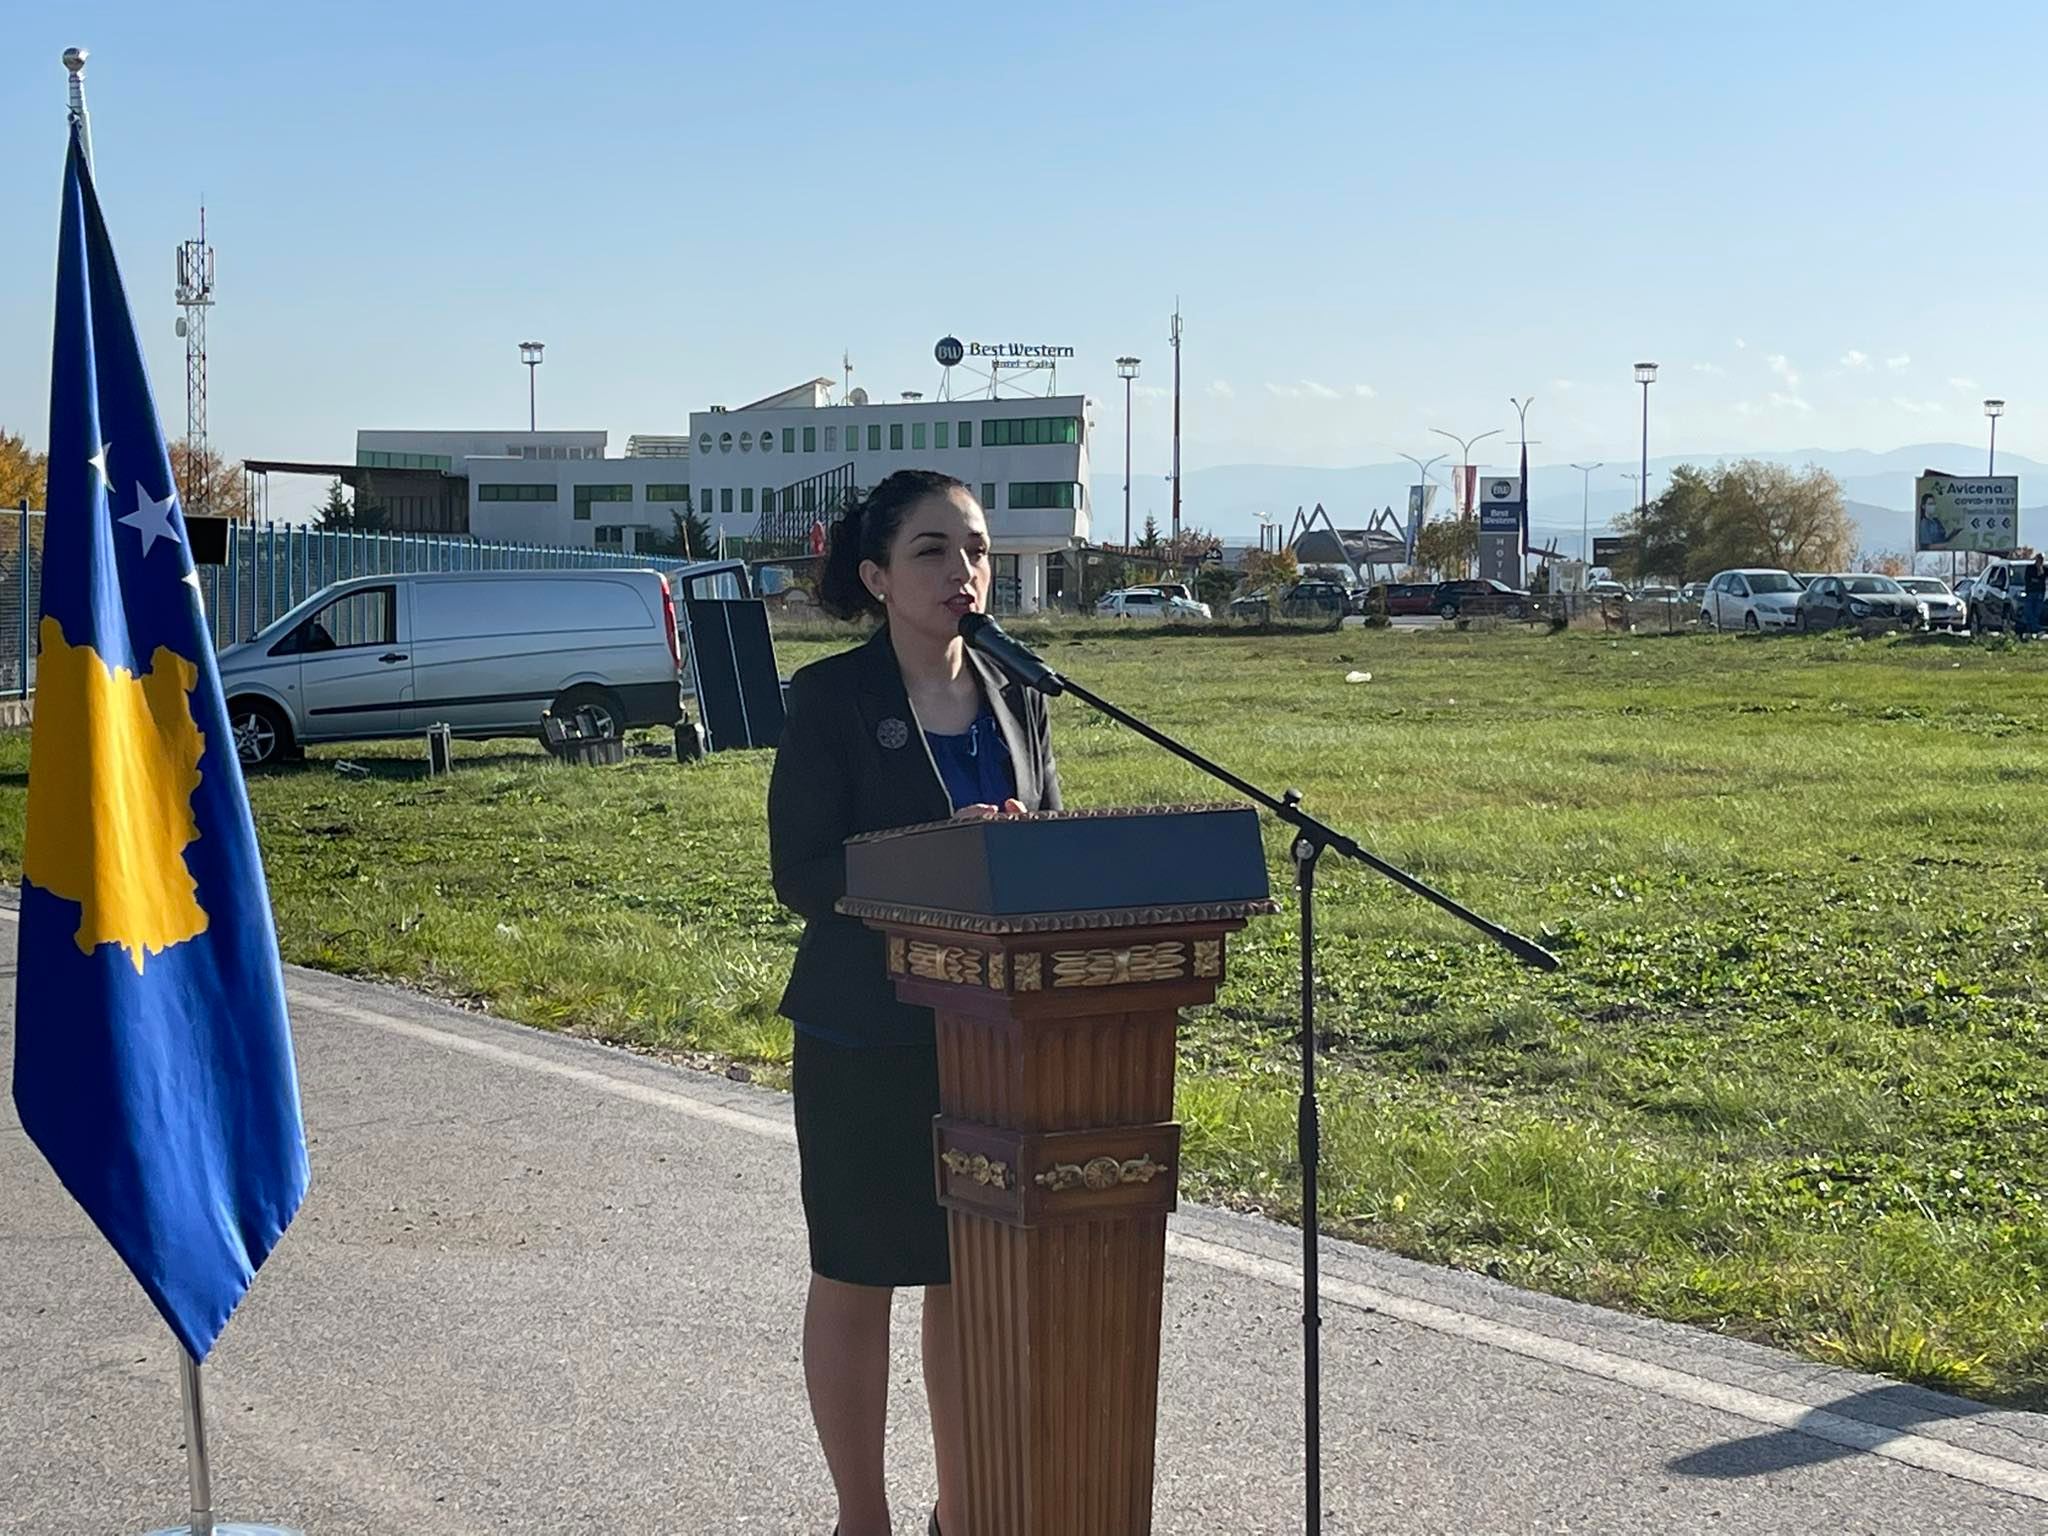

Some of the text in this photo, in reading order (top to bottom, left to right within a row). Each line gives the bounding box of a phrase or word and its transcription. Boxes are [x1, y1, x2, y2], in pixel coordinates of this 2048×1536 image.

[938, 346, 961, 360] BW
[970, 342, 1074, 357] Best Western
[1947, 483, 2002, 494] Avicena
[1490, 509, 1509, 517] Best
[1483, 517, 1517, 525] Western
[1496, 538, 1504, 579] HOTE
